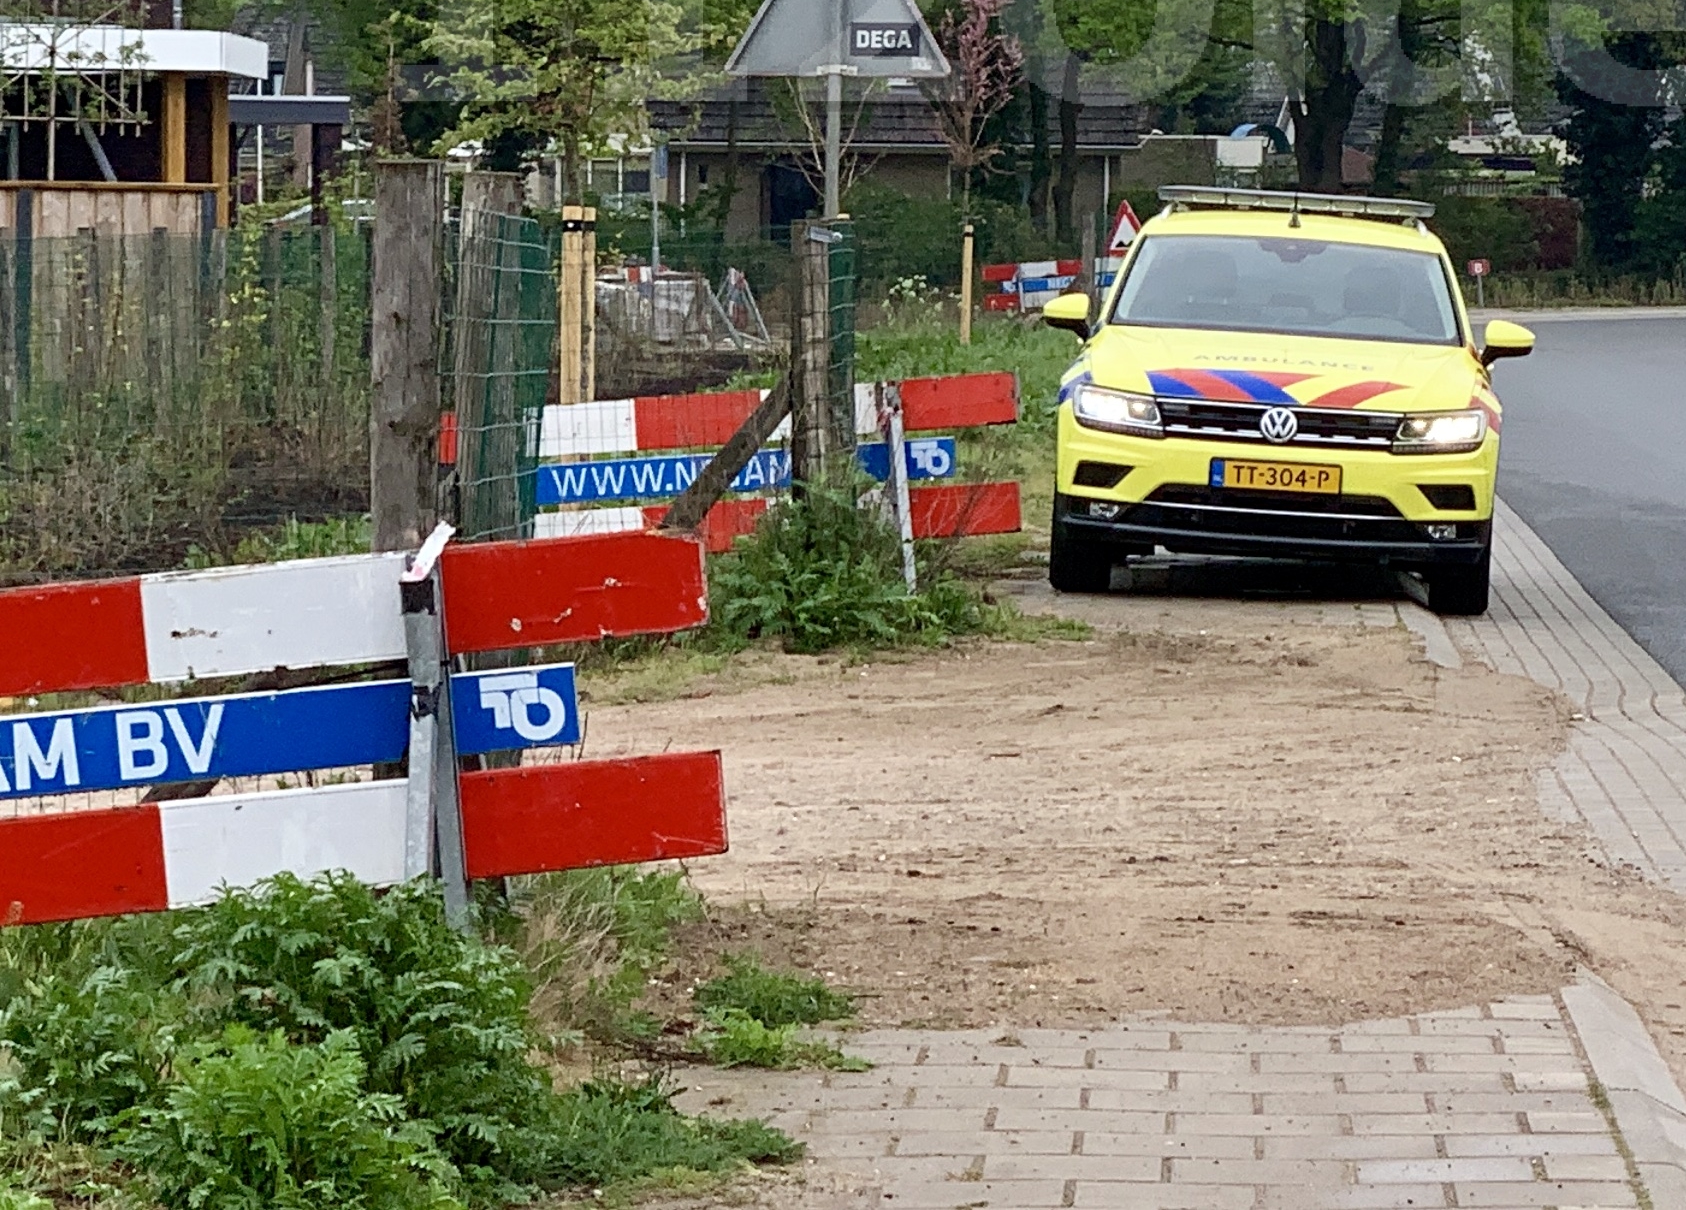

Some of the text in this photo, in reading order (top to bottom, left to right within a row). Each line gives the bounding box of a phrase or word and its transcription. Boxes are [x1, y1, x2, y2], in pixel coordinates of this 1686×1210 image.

[856, 30, 913, 49] DEGA
[1194, 354, 1375, 372] AMBULANCE
[1233, 465, 1330, 488] TT-304-P
[115, 703, 225, 781] BV
